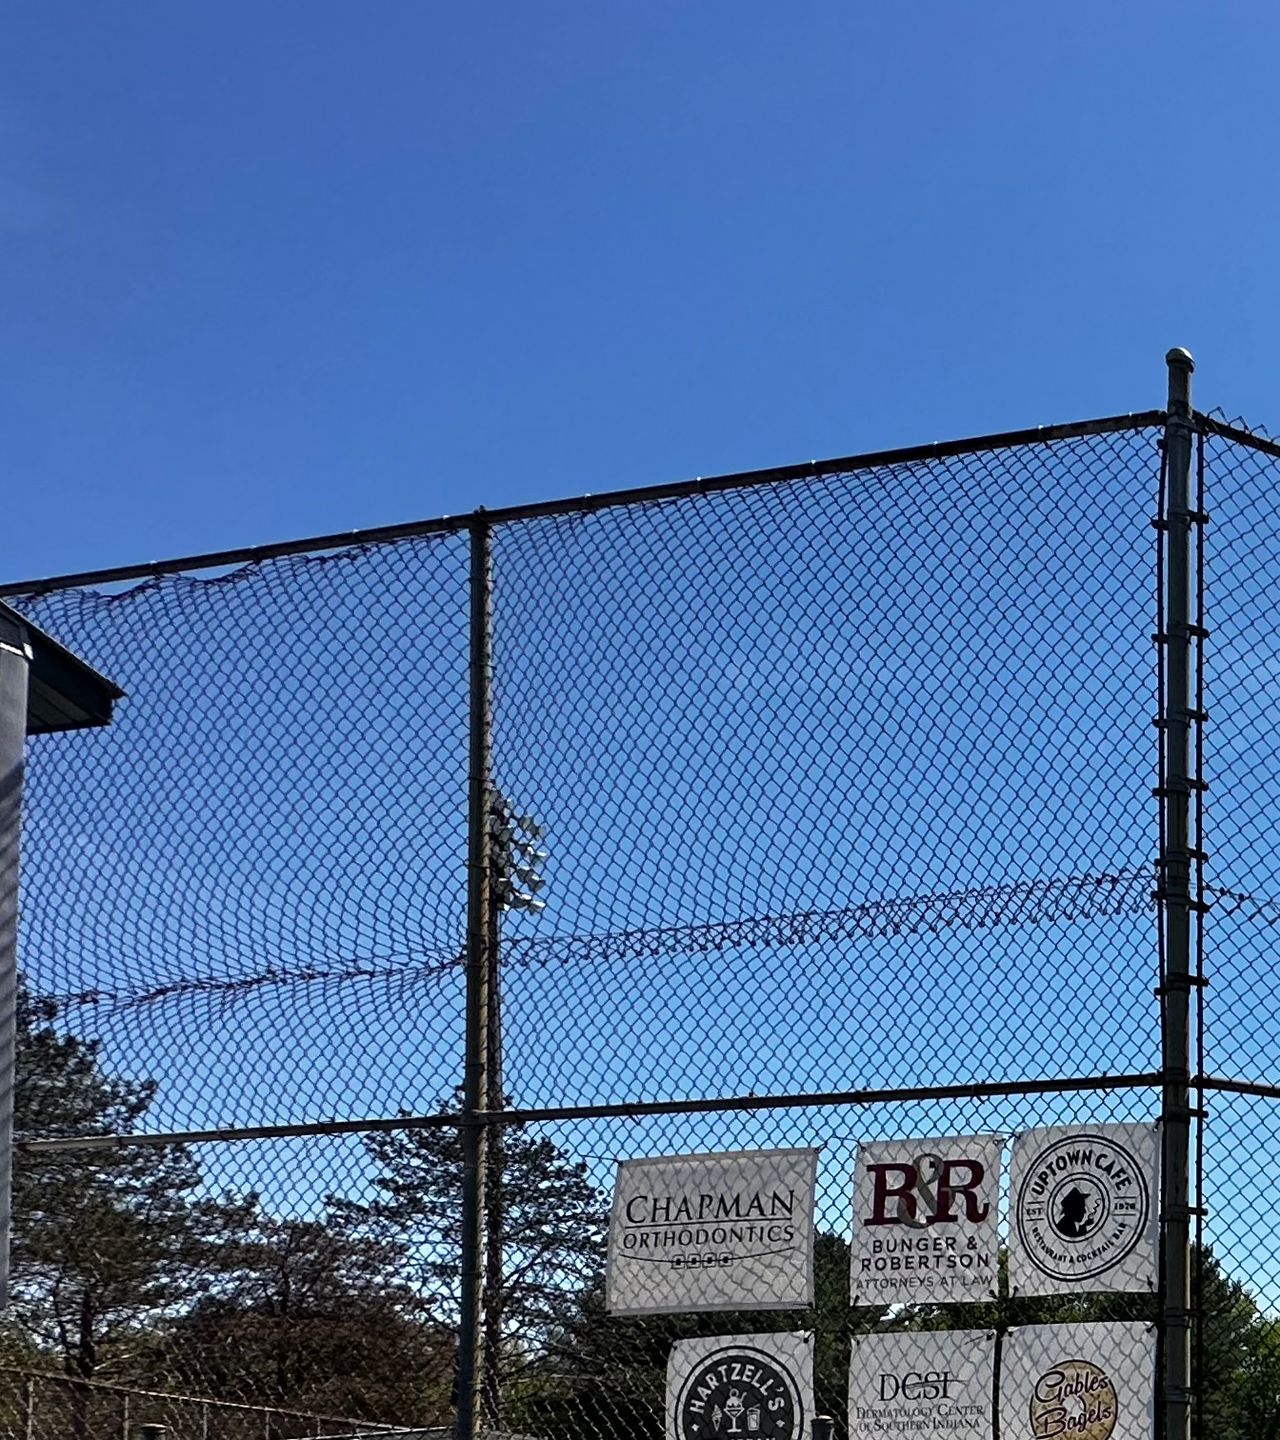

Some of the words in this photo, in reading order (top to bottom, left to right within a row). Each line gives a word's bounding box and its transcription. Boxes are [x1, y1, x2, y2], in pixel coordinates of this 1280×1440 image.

[1032, 1150, 1093, 1196] UPTOWN
[1094, 1153, 1133, 1191] CAFE
[626, 1190, 795, 1224] CHAPMAN
[623, 1225, 795, 1249] ORTHODONTICS
[873, 1237, 957, 1254] BUNGER
[966, 1236, 978, 1251] &
[1032, 1227, 1067, 1263] RESTAURANT
[1076, 1239, 1114, 1263] COCKTAIL
[1112, 1222, 1127, 1240] BAR
[861, 1253, 989, 1272] ROBERTSON
[856, 1276, 934, 1290] ATTORNEYS
[940, 1276, 955, 1287] AT
[962, 1275, 993, 1286] LAW
[689, 1363, 785, 1414] HARTZELL'S
[879, 1371, 951, 1401] DCSI
[1035, 1370, 1108, 1403] Gables
[856, 1406, 932, 1419] DERMATOLOGY
[938, 1404, 983, 1416] CENTER
[933, 1417, 980, 1430] INDIANA
[1035, 1401, 1111, 1440] Bagels
